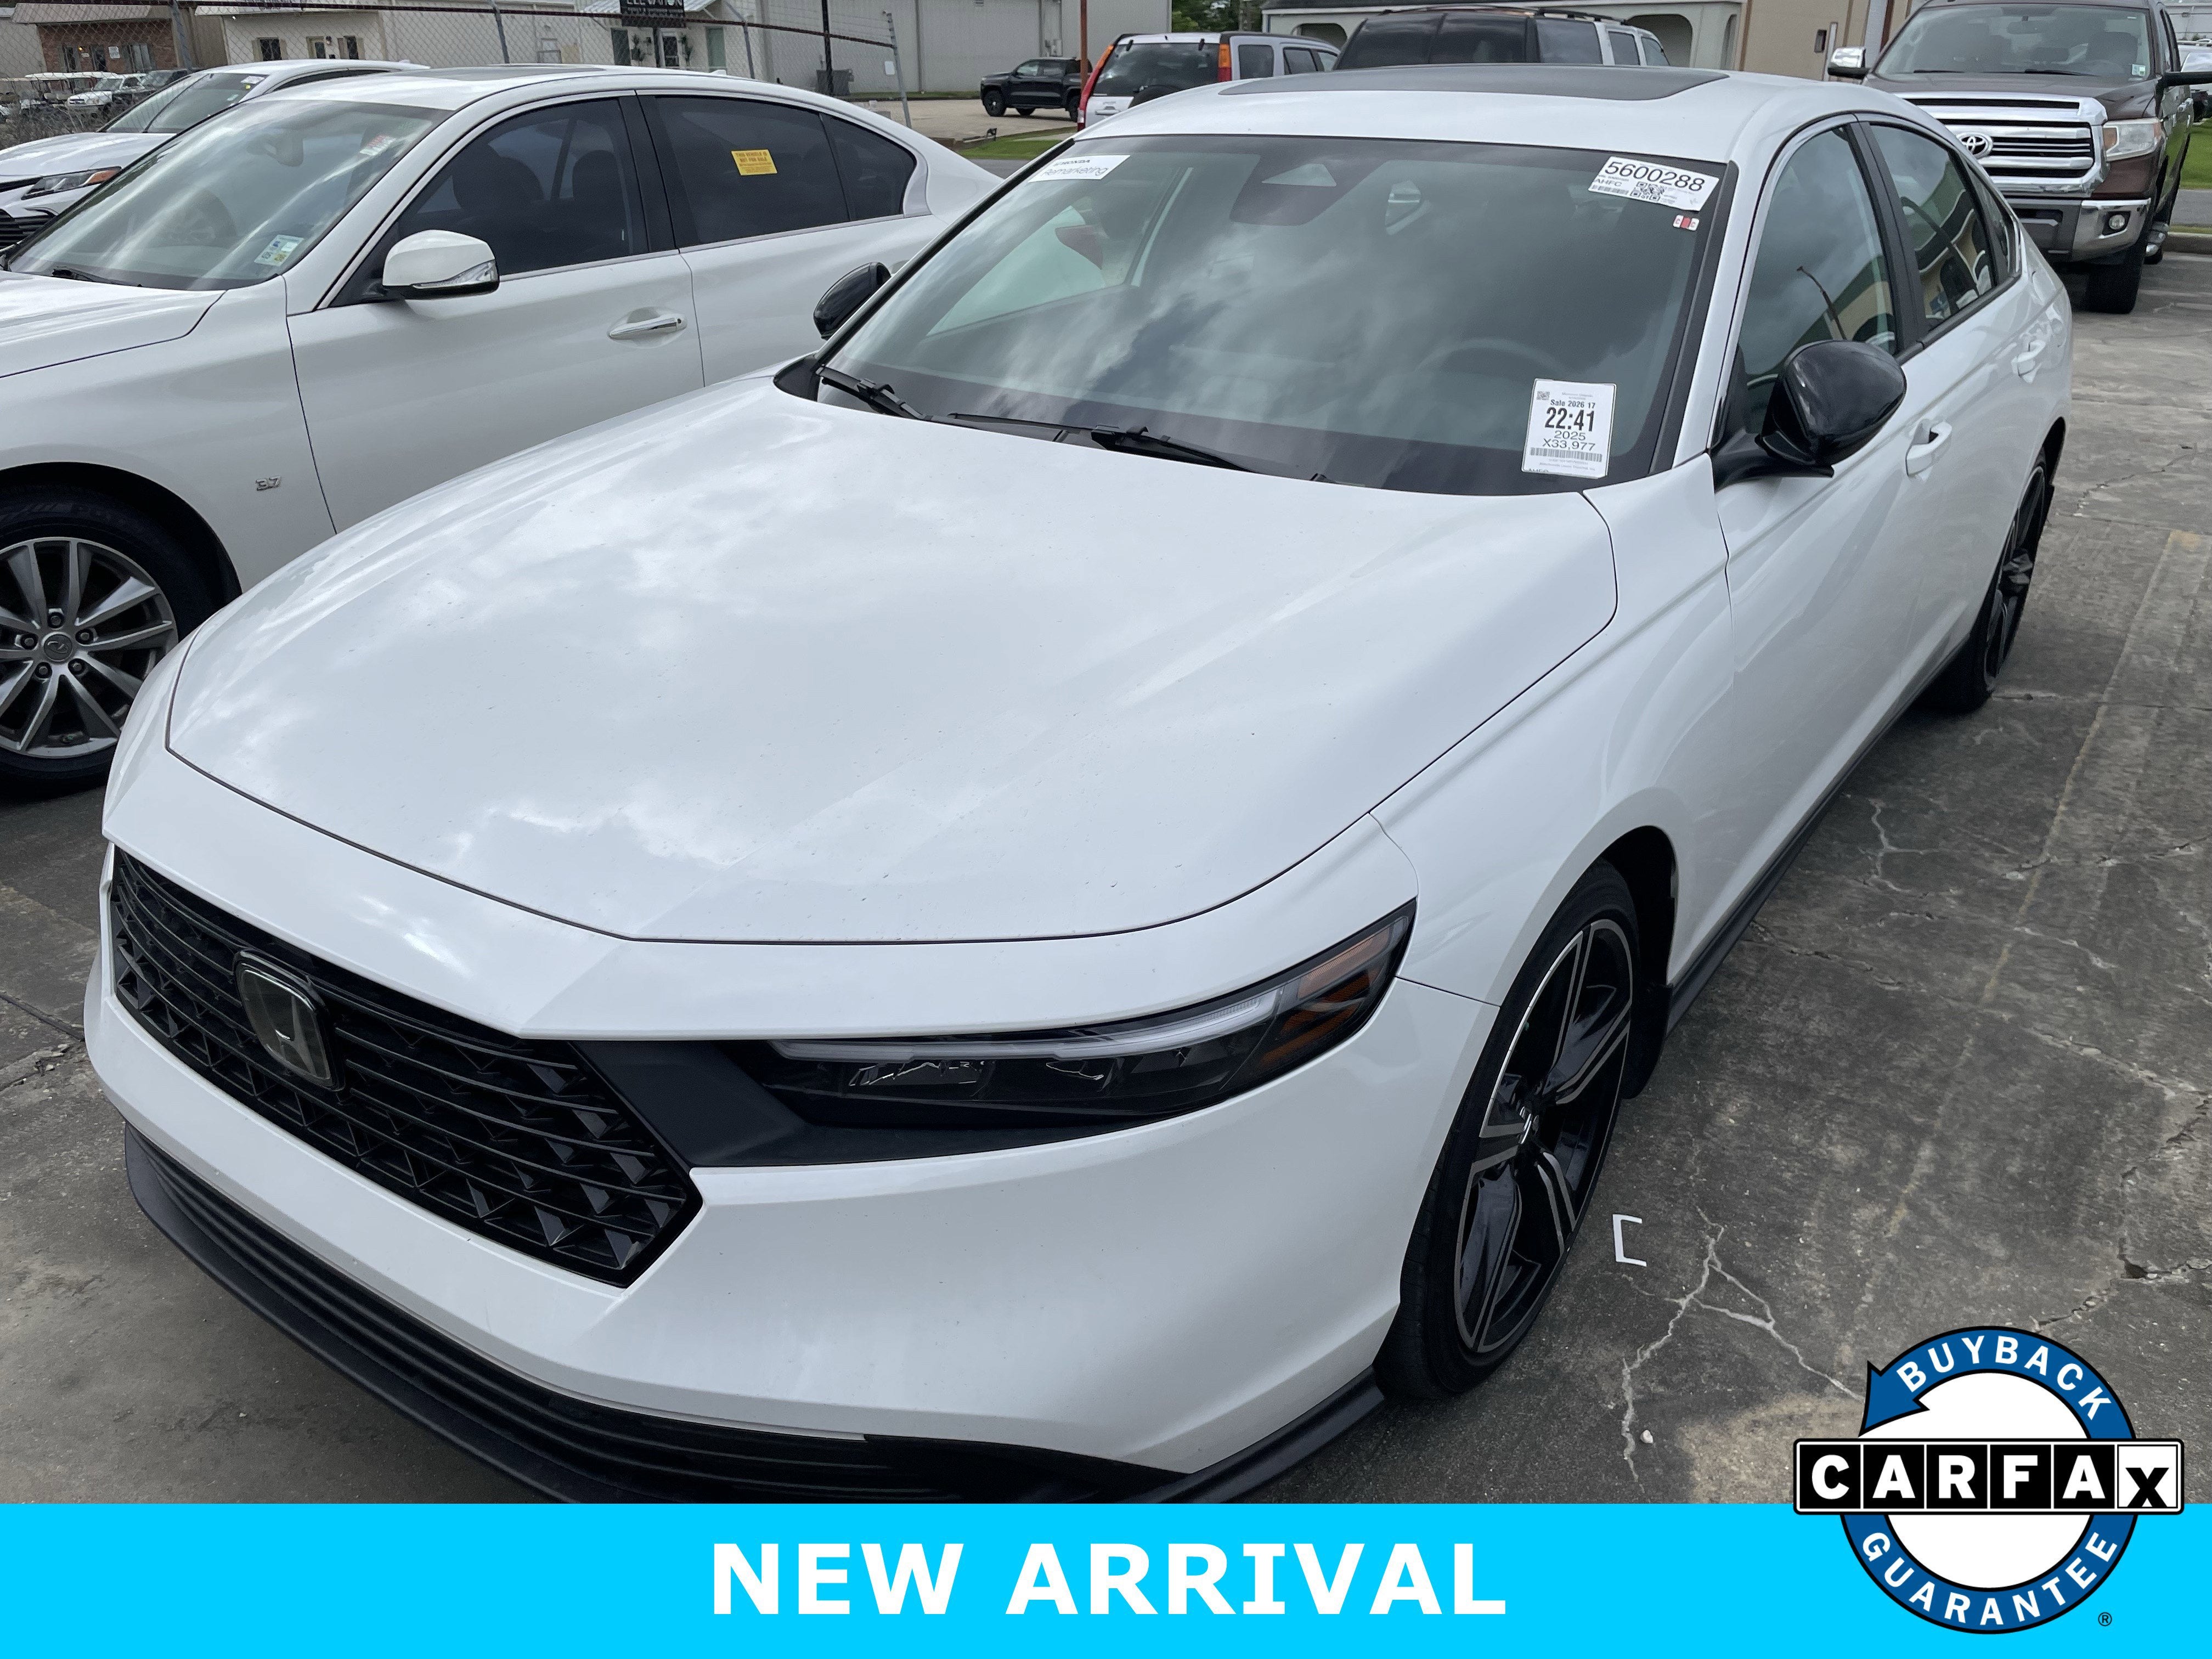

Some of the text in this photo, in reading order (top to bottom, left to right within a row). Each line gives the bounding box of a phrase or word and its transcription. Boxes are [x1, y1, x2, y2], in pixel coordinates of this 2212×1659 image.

[1041, 166, 1109, 176] Remarketing
[1605, 161, 1705, 191] 5600288
[1544, 407, 1594, 432] 22:41
[1554, 430, 1586, 441] 2025
[1543, 438, 1596, 451] X33,977
